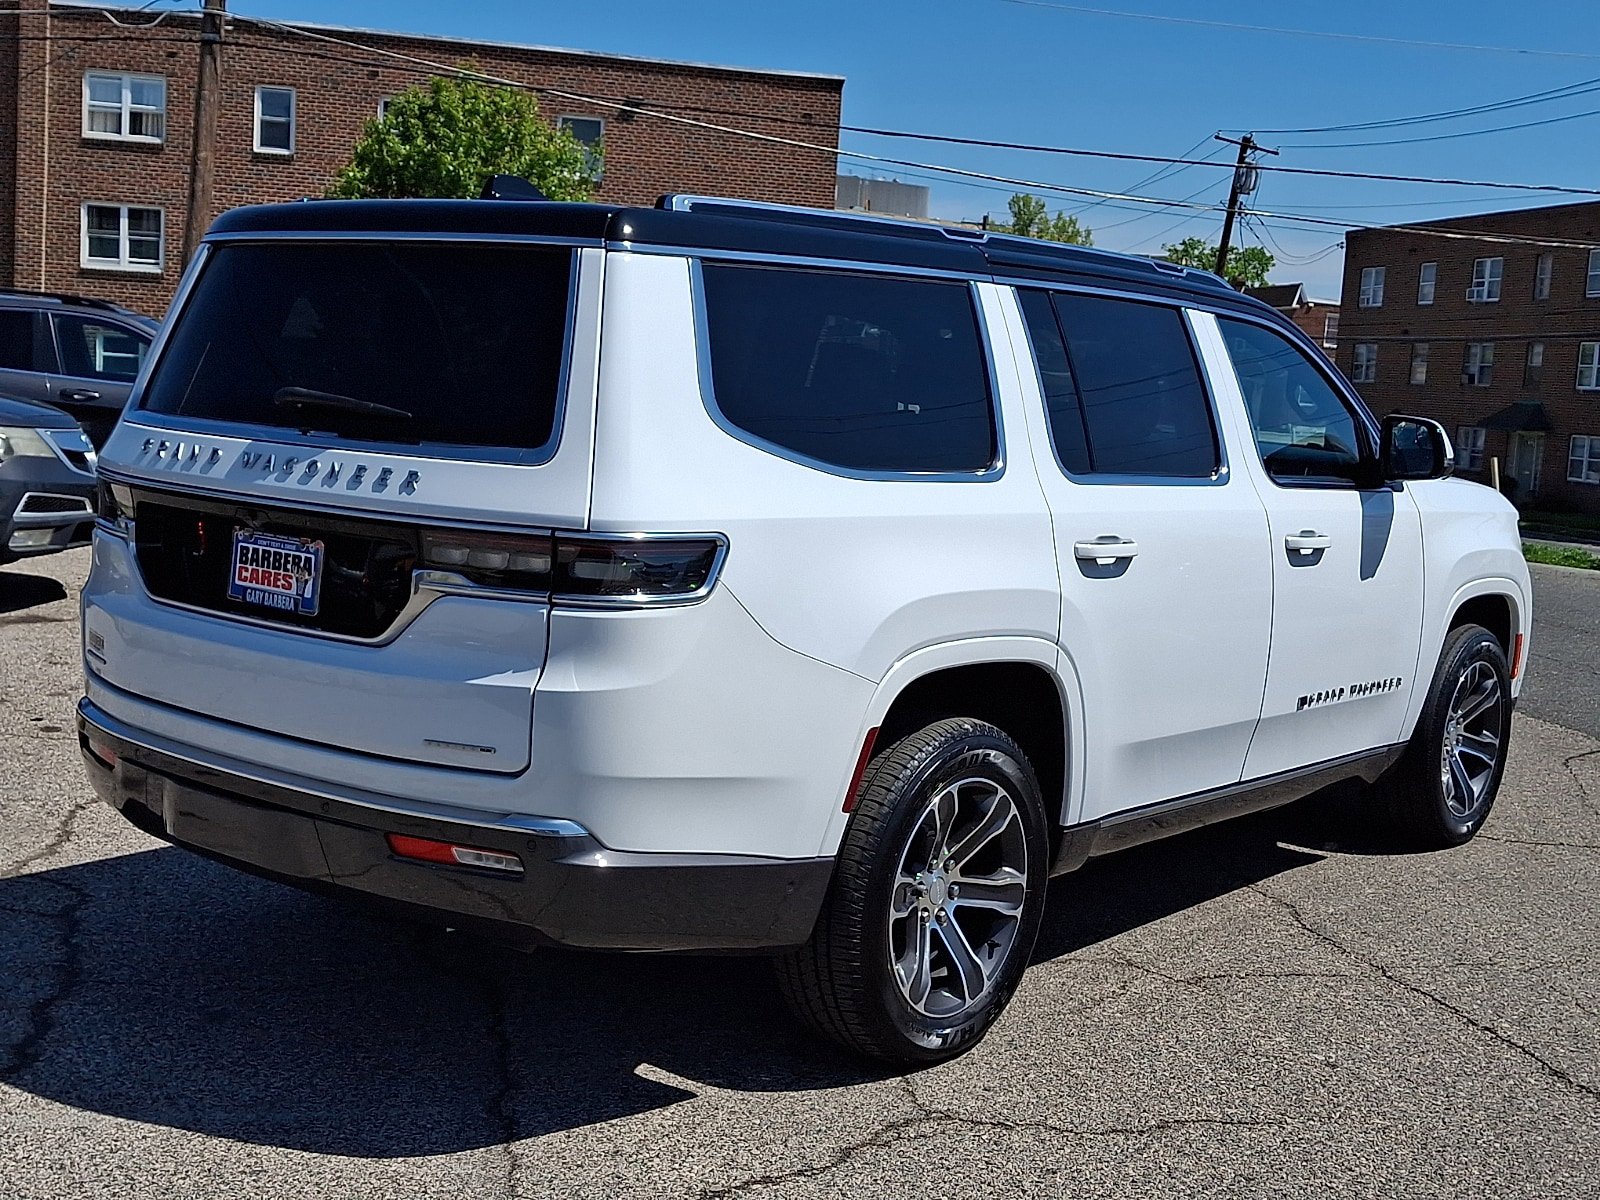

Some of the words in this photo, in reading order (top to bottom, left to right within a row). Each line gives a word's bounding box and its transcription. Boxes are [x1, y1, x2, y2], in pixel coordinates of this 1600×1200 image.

[141, 438, 223, 466] GRAND
[242, 451, 421, 491] WAGONEER
[239, 544, 313, 576] BARBERA
[237, 565, 294, 591] CARES
[246, 588, 264, 604] GARY
[264, 590, 295, 611] BARBERA
